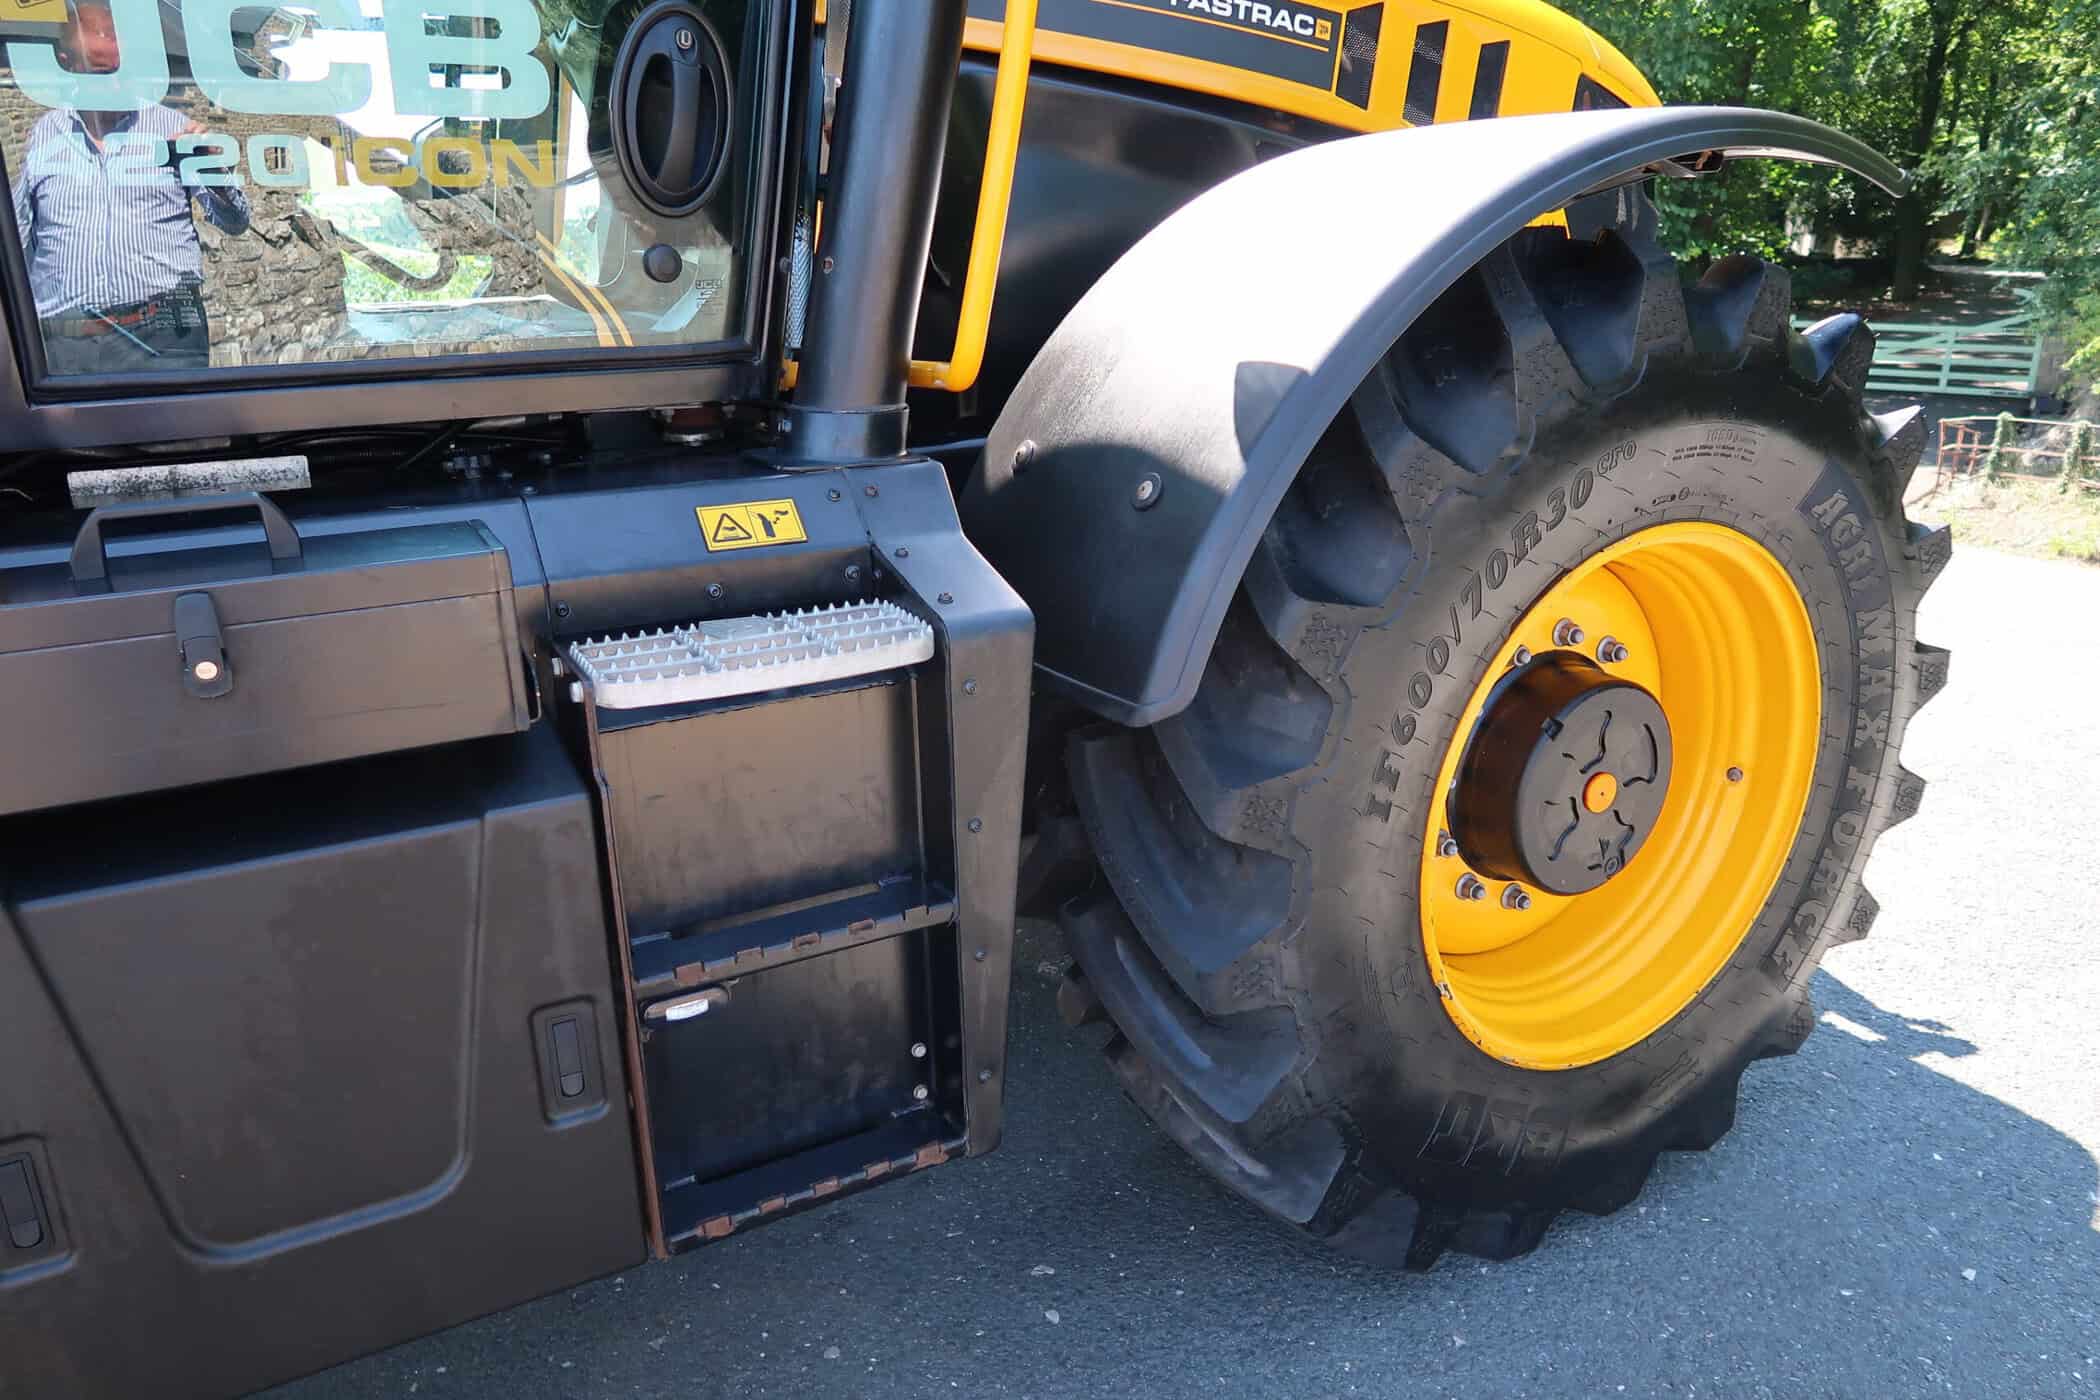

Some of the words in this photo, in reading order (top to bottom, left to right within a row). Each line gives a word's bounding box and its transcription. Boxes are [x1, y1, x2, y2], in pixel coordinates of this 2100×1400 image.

[1170, 0, 1314, 36] ASTRAC
[6, 0, 550, 119] JCB
[331, 135, 556, 187] ICON
[1597, 440, 1637, 476] CFO
